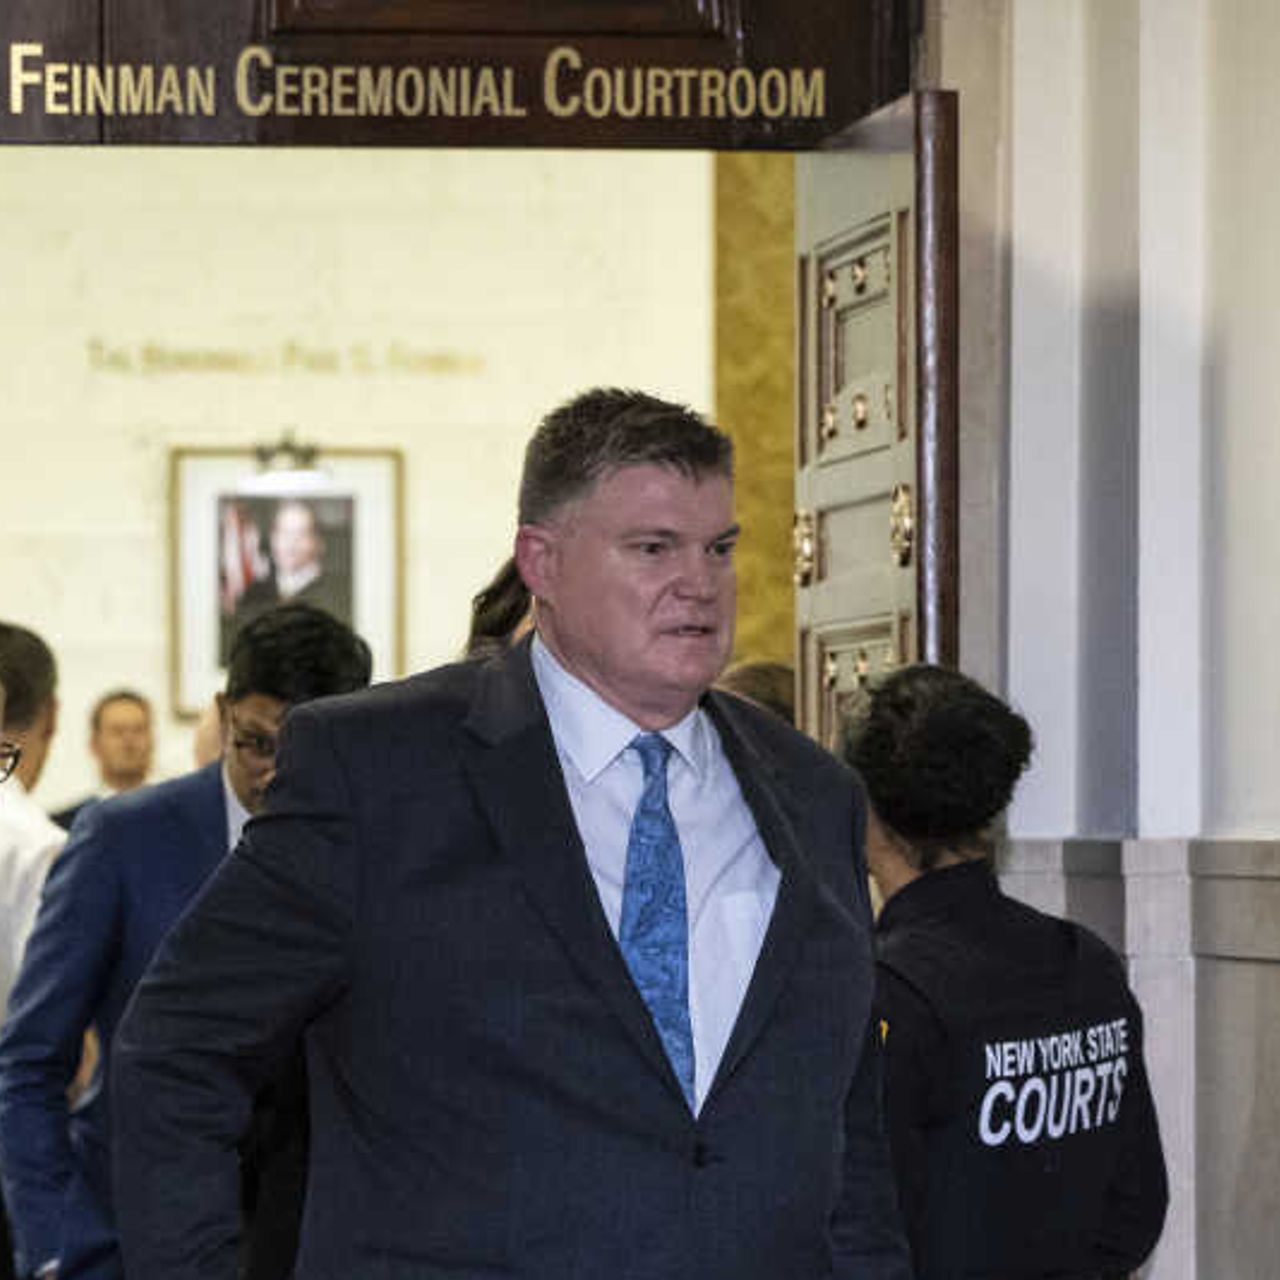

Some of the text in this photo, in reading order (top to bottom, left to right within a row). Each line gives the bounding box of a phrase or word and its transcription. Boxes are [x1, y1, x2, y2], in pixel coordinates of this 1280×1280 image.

[9, 42, 216, 117] FEINMAN
[235, 45, 527, 118] CEREMONIAL
[544, 46, 825, 119] COURTROOM
[985, 1016, 1129, 1080] NEW YORK STATE
[978, 1056, 1128, 1147] COURTS
